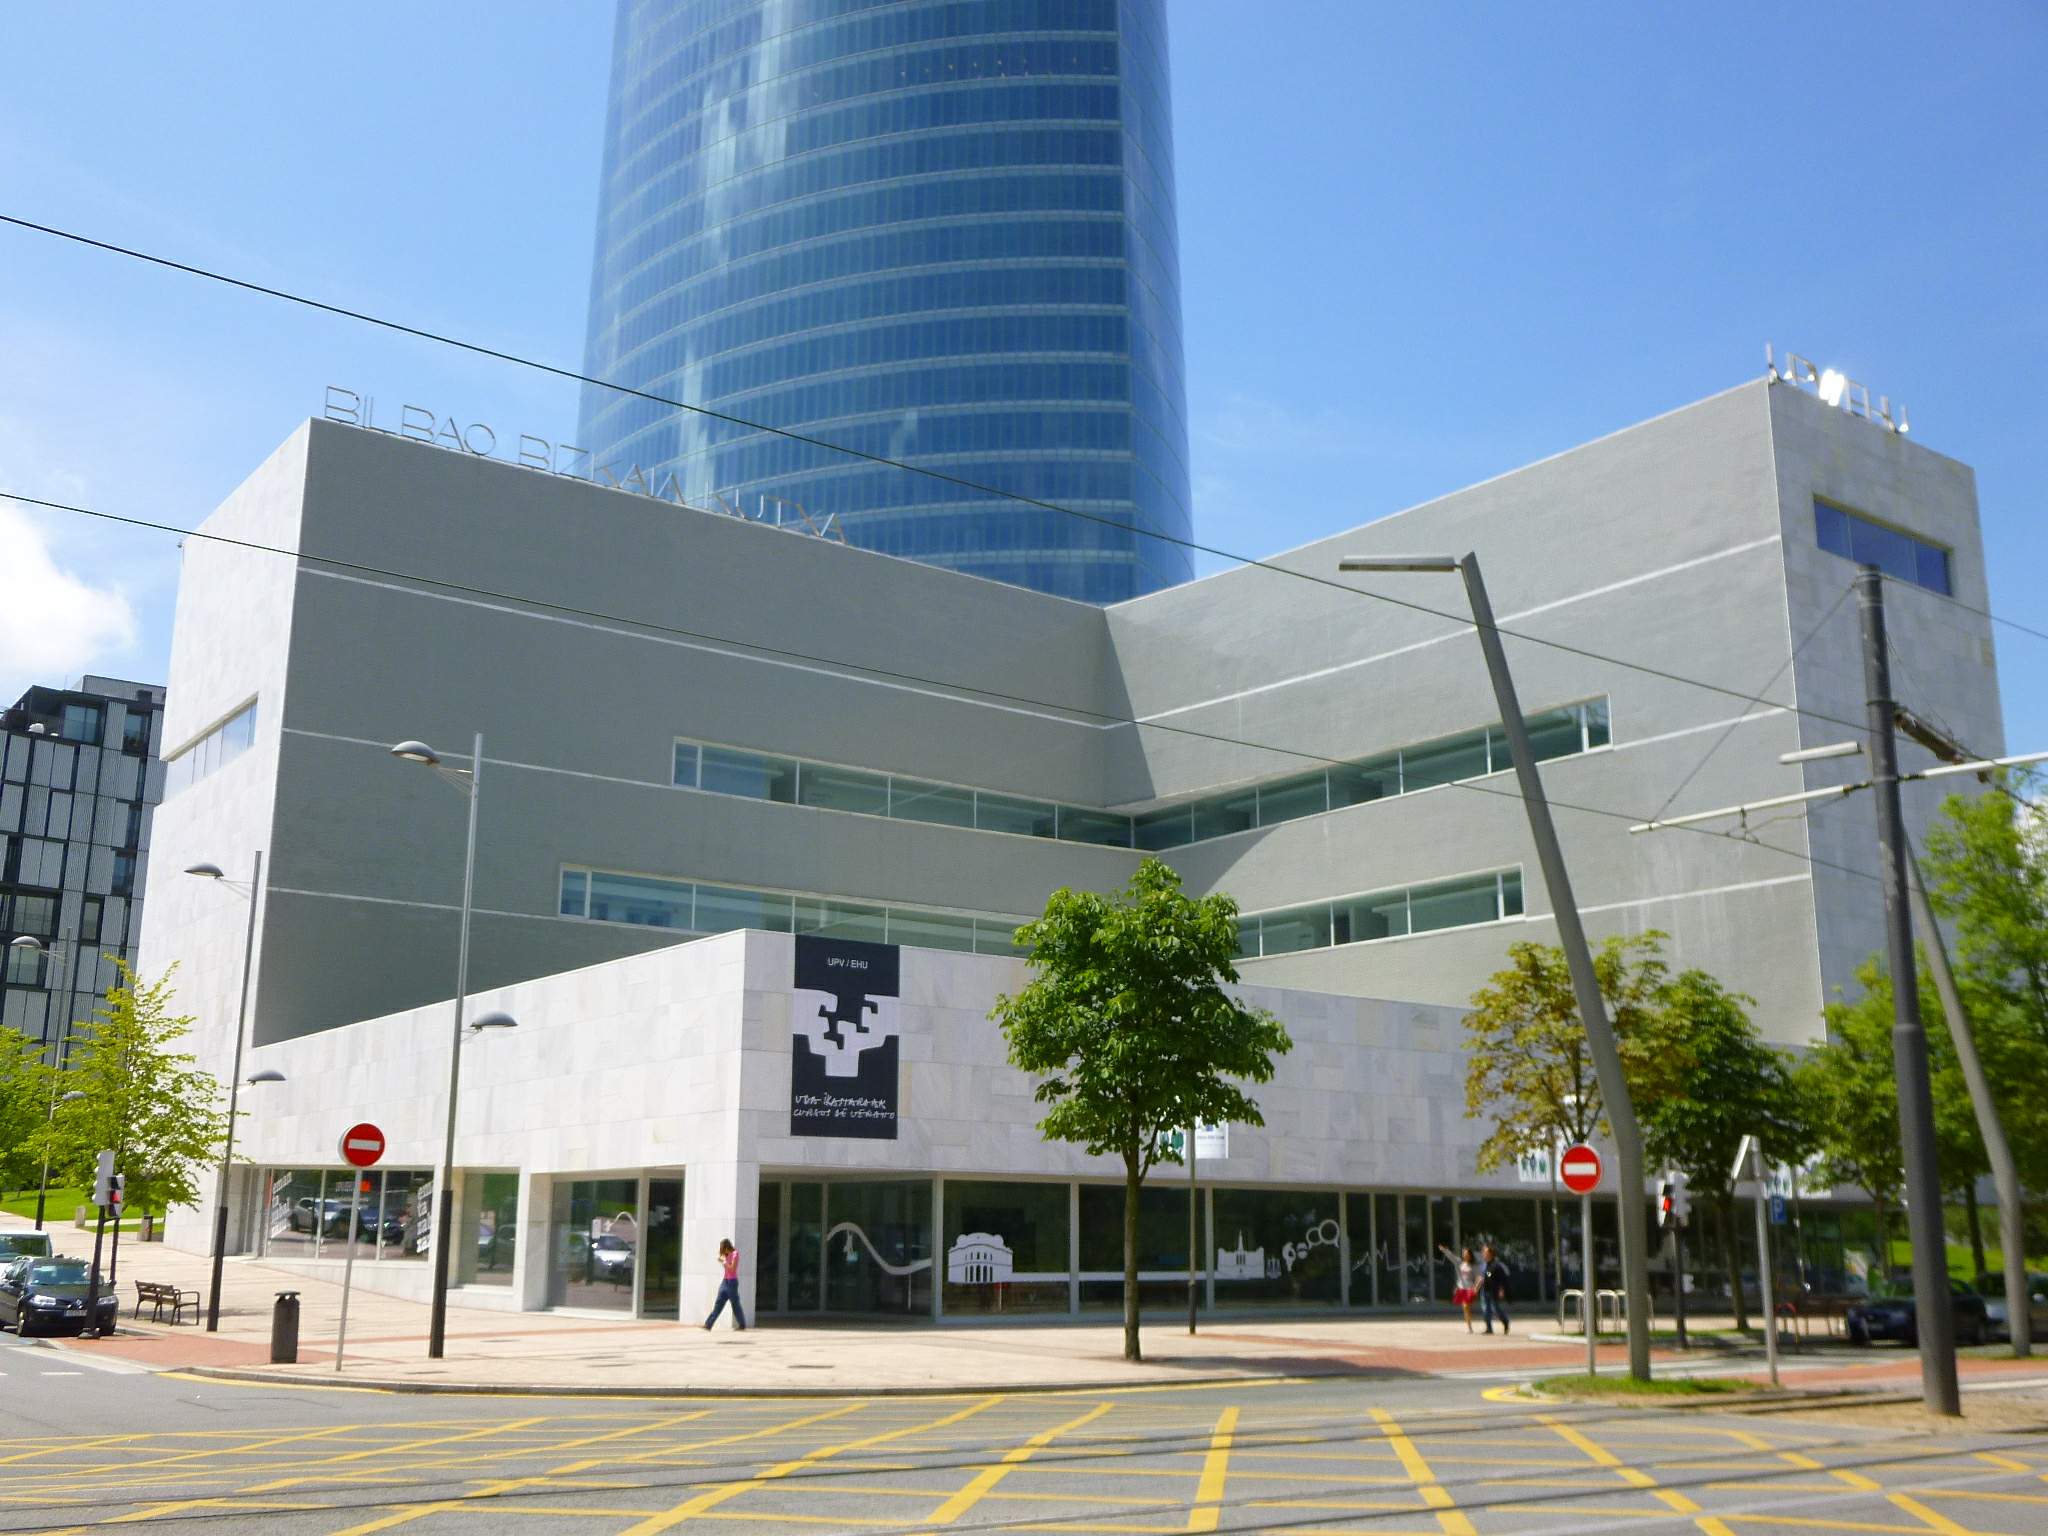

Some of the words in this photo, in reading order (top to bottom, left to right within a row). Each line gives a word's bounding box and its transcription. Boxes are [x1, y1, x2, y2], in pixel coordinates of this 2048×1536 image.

[325, 386, 495, 455] BILBAO
[827, 956, 845, 968] UPV
[851, 959, 869, 970] EHU
